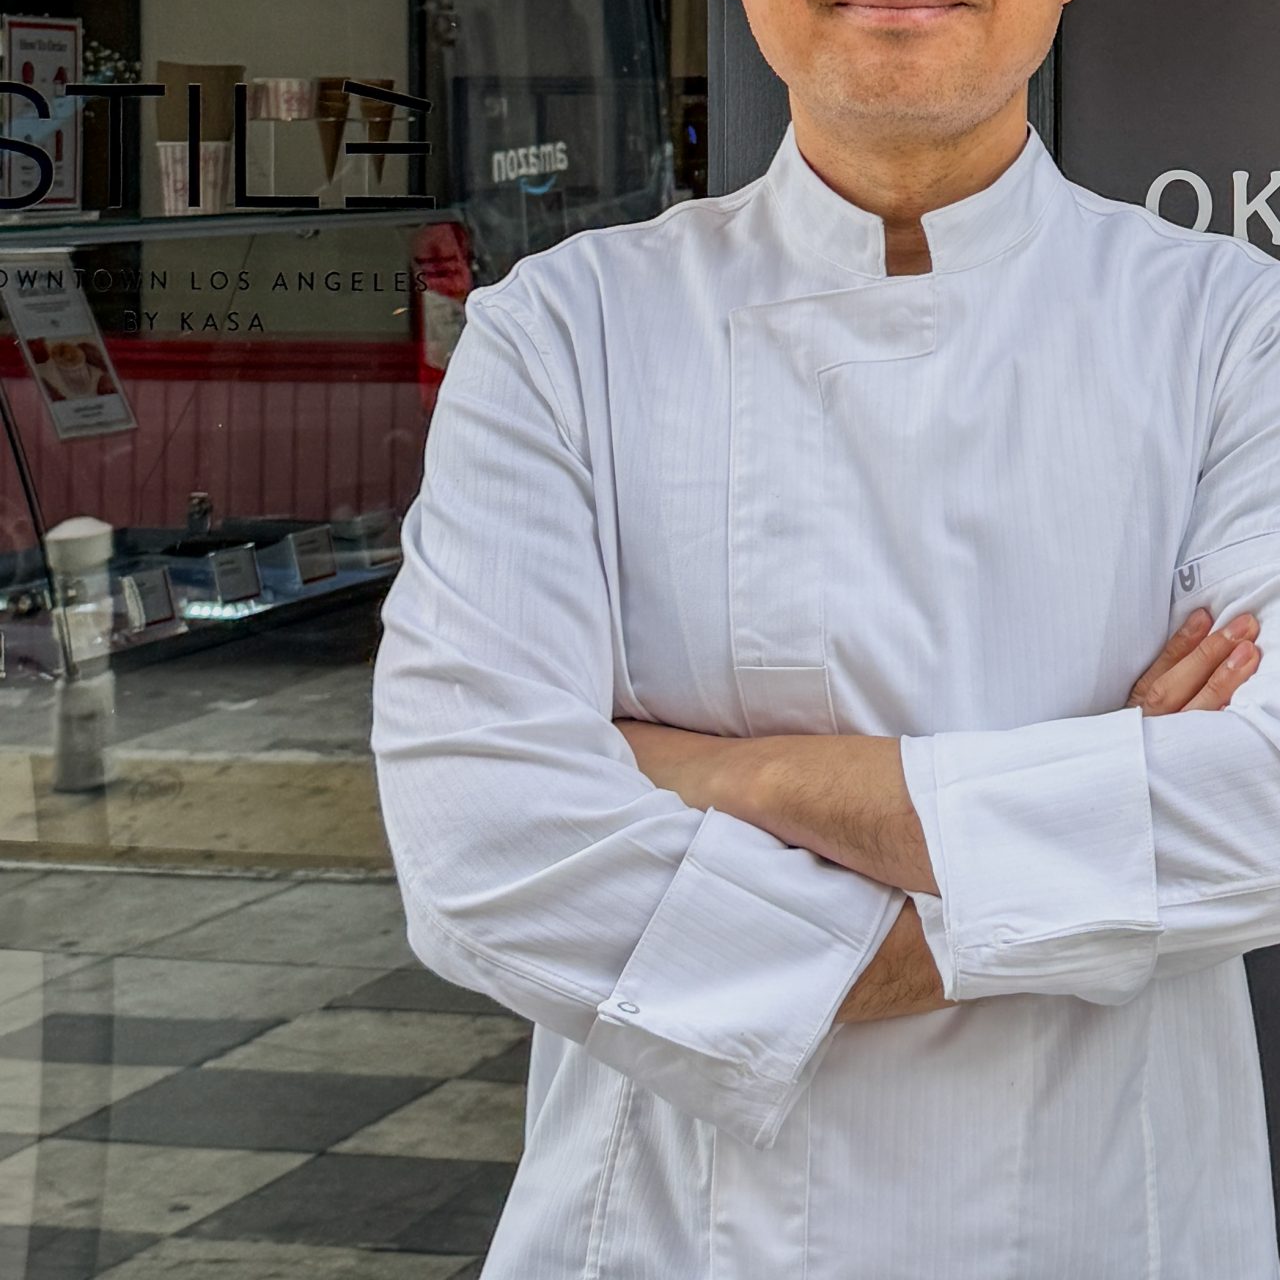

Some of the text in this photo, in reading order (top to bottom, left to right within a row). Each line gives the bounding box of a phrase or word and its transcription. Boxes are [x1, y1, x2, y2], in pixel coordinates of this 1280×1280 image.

[190, 270, 250, 291] LOS
[271, 271, 428, 292] ANGELES
[123, 310, 265, 333] BY KASA
